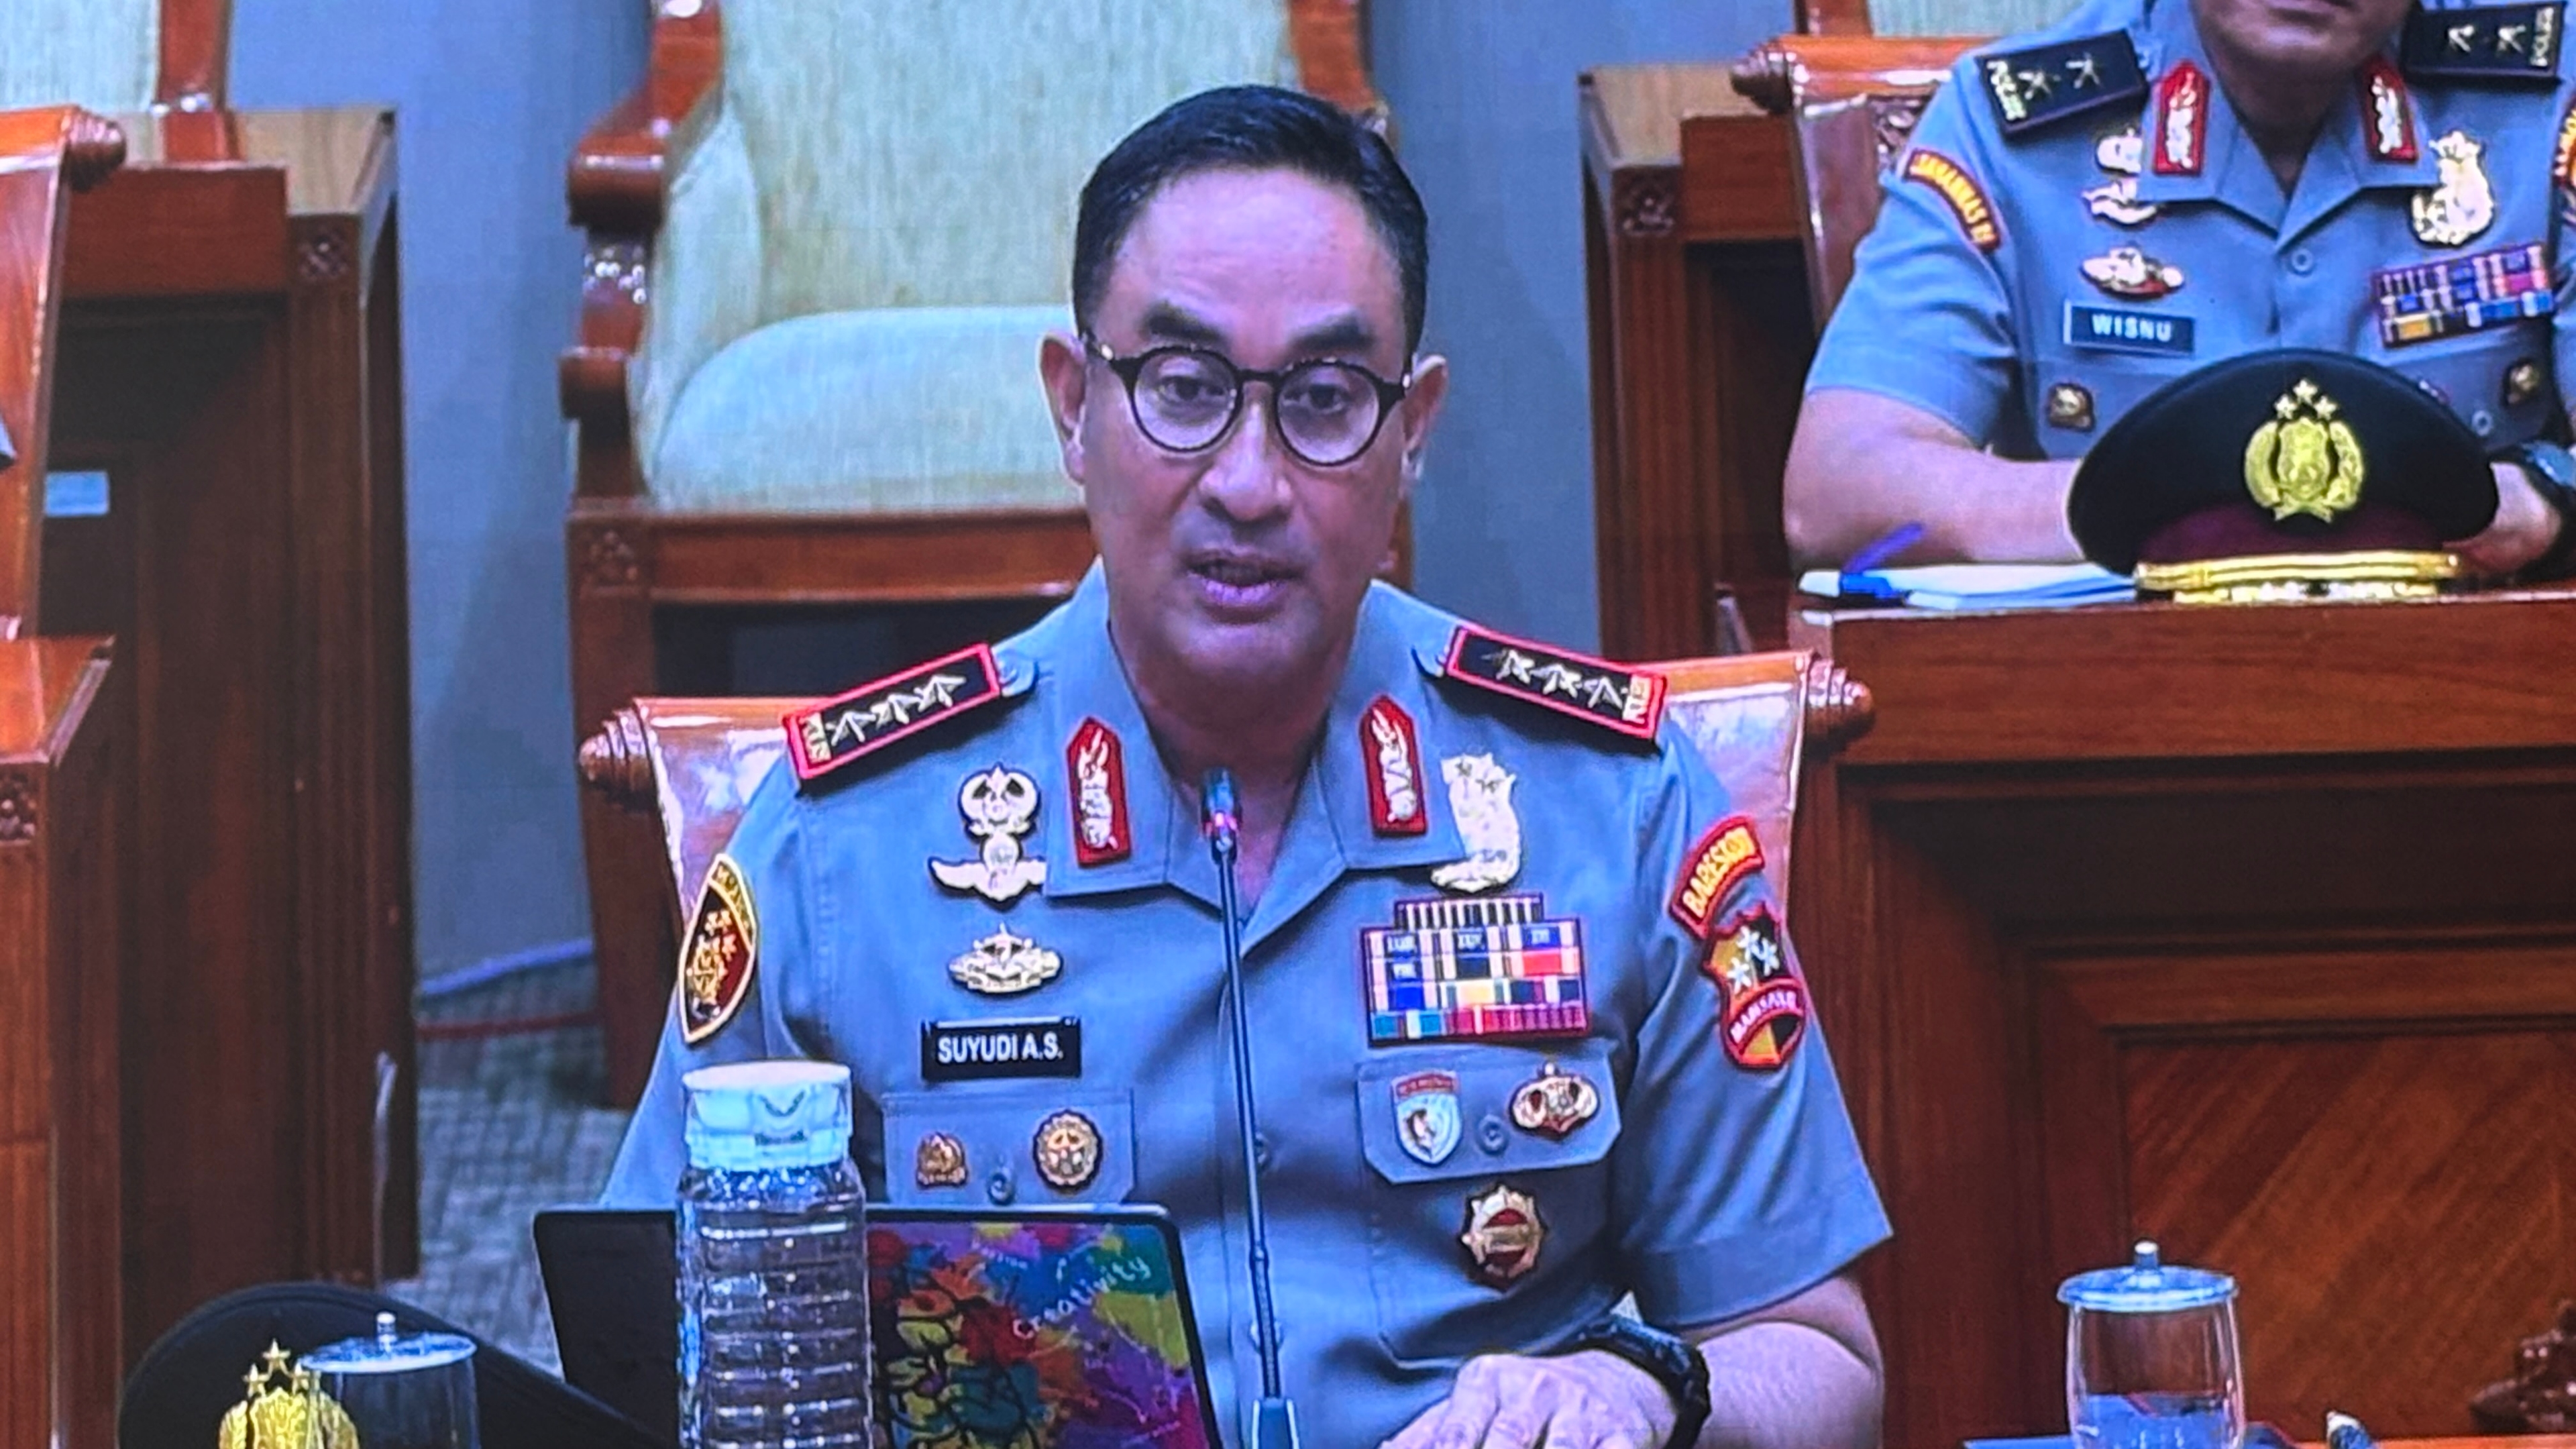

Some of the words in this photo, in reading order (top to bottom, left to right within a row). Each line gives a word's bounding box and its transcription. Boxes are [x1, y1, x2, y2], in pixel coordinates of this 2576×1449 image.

[2091, 313, 2172, 342] WISNU
[937, 1032, 1018, 1064] SUYUDI
[1022, 1032, 1063, 1061] A.S.
[1012, 1254, 1152, 1340] Creativity
